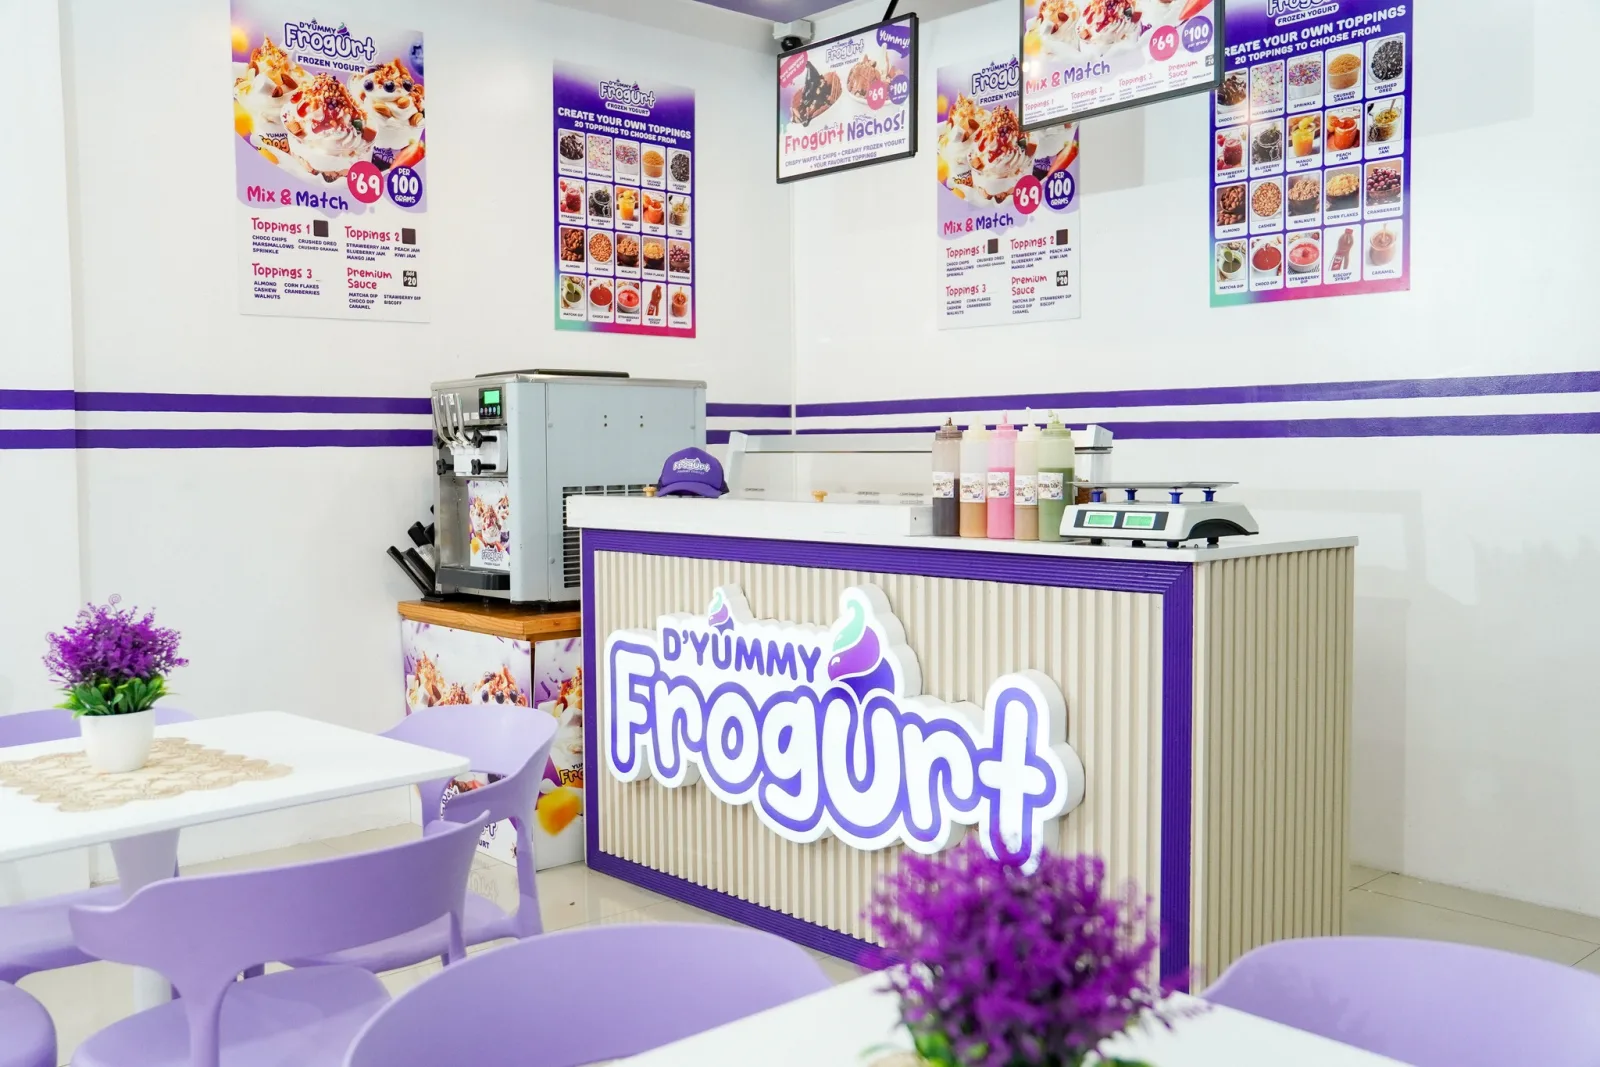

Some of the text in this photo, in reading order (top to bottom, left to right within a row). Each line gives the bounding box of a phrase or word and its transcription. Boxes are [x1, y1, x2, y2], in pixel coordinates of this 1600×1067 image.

[1277, 12, 1306, 24] FROZEN
[1307, 5, 1337, 17] YOGURT
[299, 21, 336, 34] D'YUMMY
[1224, 39, 1260, 57] REATE
[1263, 29, 1298, 48] YOUR
[1300, 22, 1333, 40] OWN
[1336, 5, 1406, 31] TOPPINGS
[284, 22, 375, 61] Frogurt
[880, 30, 910, 48] Yummy!
[1235, 24, 1381, 65] 20 TOPPINGS TO CHOOSE FROM
[825, 38, 864, 63] Frogurt
[297, 55, 365, 73] FROZEN YOGURT
[981, 62, 1008, 74] D'YUMMY
[1168, 60, 1198, 71] Premium
[971, 65, 1020, 95] Frogu
[1025, 60, 1110, 94] Mix & Match
[1119, 74, 1147, 87] Toppings
[1168, 70, 1188, 79] Sauce
[1374, 82, 1397, 91] CRUSHED
[600, 81, 655, 107] Frogurt
[980, 93, 1003, 104] FROZEN
[1071, 88, 1098, 100] Toppings
[1333, 91, 1356, 99] CRUSHED
[607, 102, 649, 115] FROZEN YOGURT
[1025, 100, 1050, 111] Toppings
[1293, 100, 1316, 109] SPRINKLE
[557, 107, 691, 139] CREATE YOUR OWN TOPPINGS
[574, 120, 677, 144] 20 TOPPINGS TO CHOOSE FROM
[785, 110, 905, 154] Frogurt Nachos!
[785, 138, 906, 167] CRISPY WAFFLE CHIPS CREAMY FROZEN YOGURT
[828, 156, 851, 166] FAVORITE
[852, 151, 877, 161] TOPPINGS
[398, 167, 410, 176] PER
[1217, 169, 1245, 177] STRAWBERRY
[1254, 163, 1280, 171] BLUEBERRY
[1053, 171, 1065, 179] PER
[391, 175, 419, 195] 100
[1048, 177, 1072, 199] 100
[247, 185, 348, 210] Mix & Match
[395, 195, 416, 204] GRAMS
[1050, 198, 1069, 206] GRAMS
[1366, 206, 1401, 215] CRANBERRIES
[251, 217, 310, 234] Toppings 1
[943, 212, 1014, 235] Mix & Match
[344, 225, 400, 242] Toppings 2
[1010, 235, 1055, 250] Toppings 2
[945, 244, 986, 258] Toppings 1
[251, 262, 312, 279] Toppings 3
[347, 267, 392, 279] Premium
[347, 278, 377, 289] Sauce
[1011, 275, 1048, 285] Premium
[945, 283, 987, 297] Toppings 3
[1011, 286, 1035, 296] Sauce
[663, 627, 821, 684] D'YUMMY
[609, 640, 1057, 867] Frogurt
